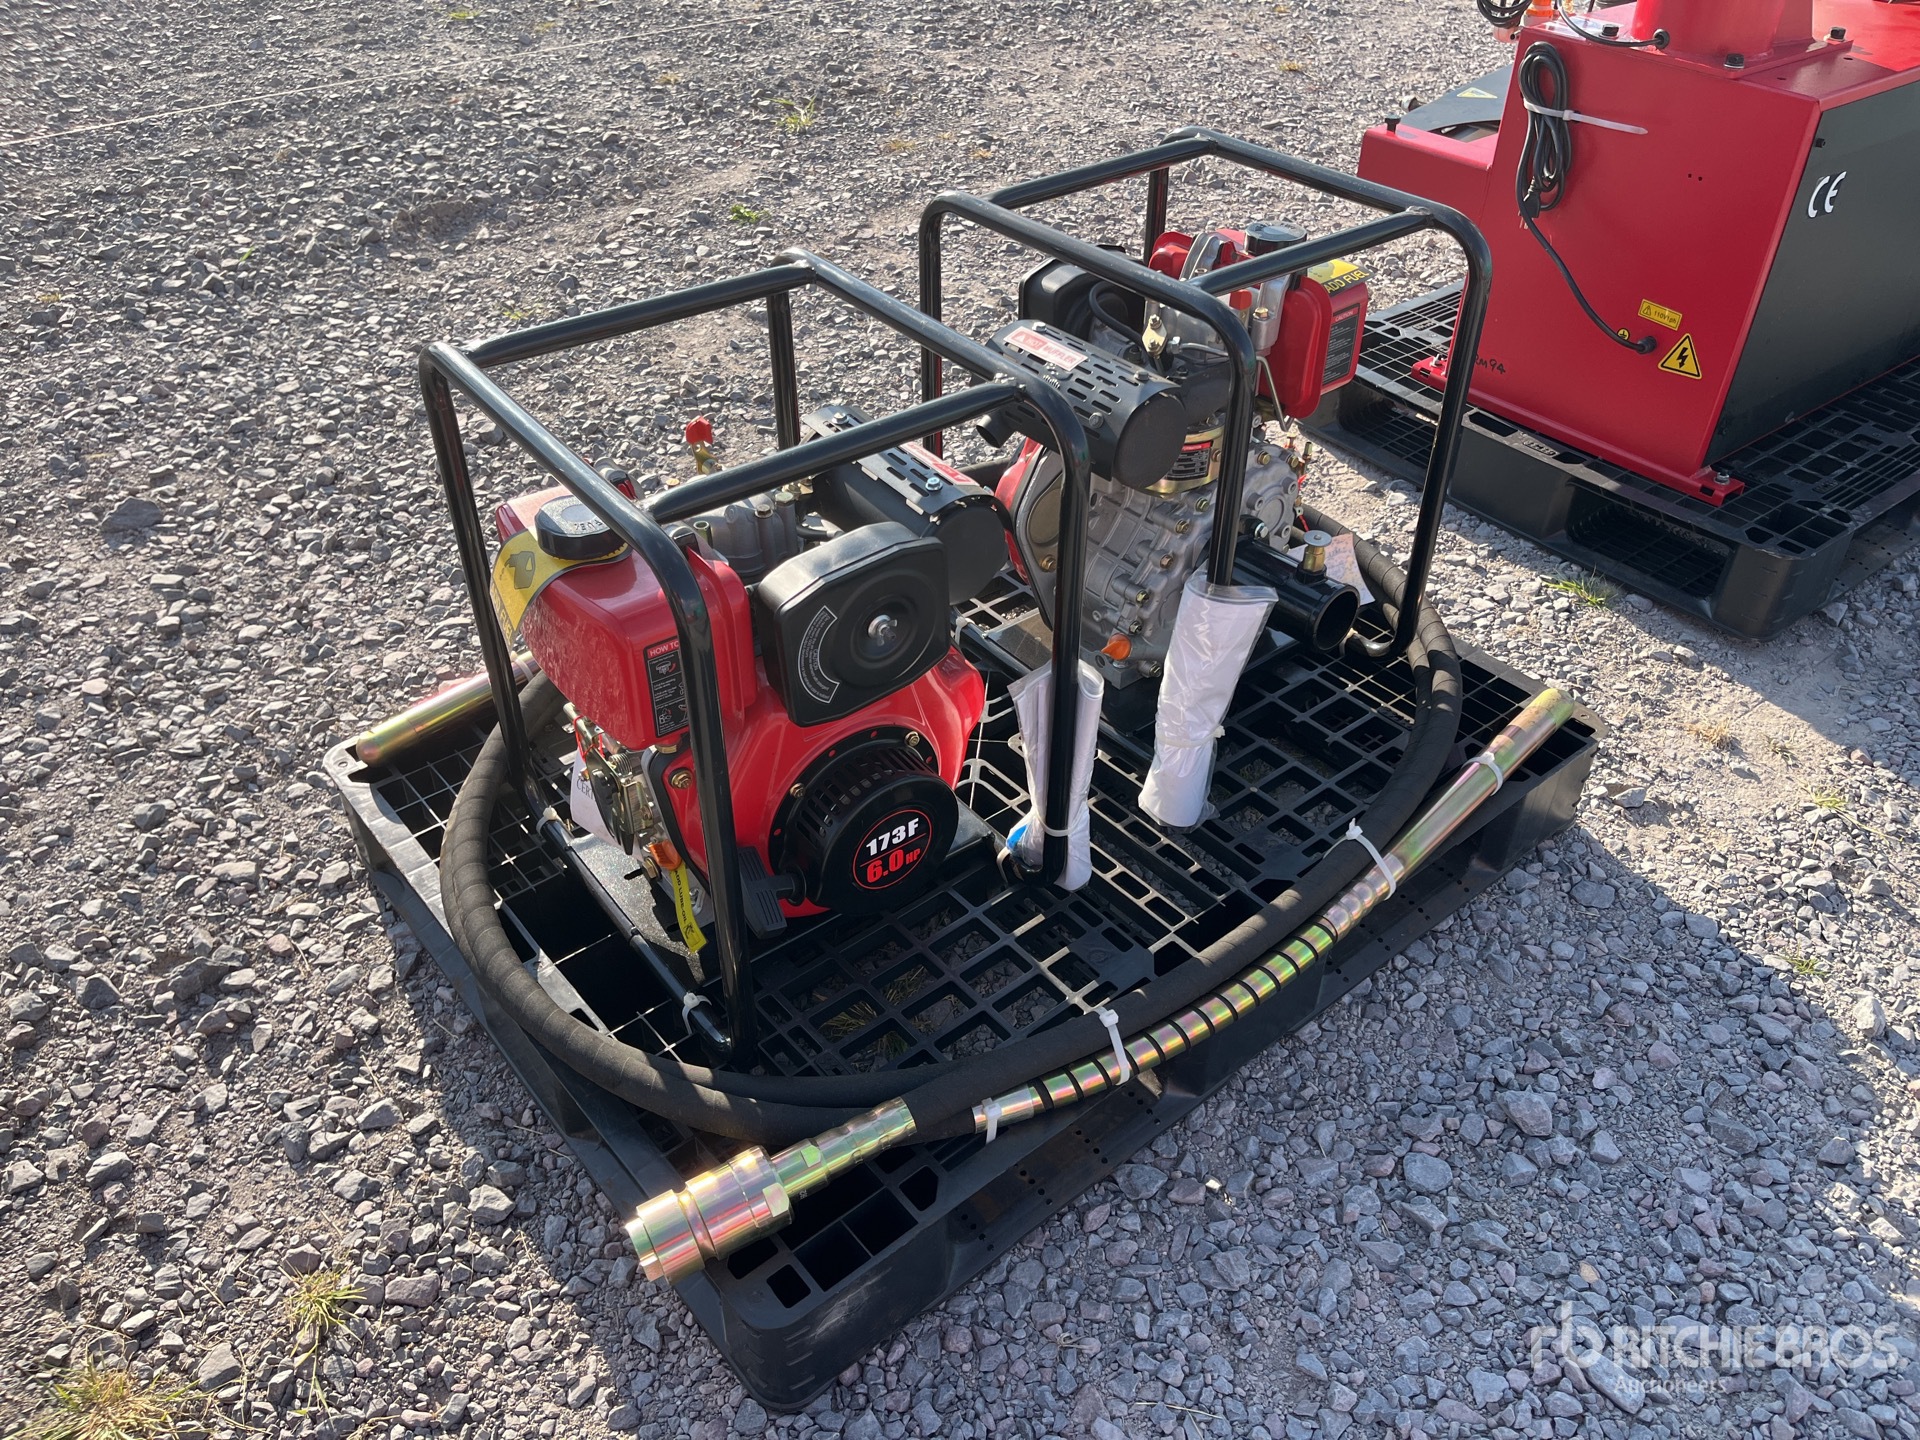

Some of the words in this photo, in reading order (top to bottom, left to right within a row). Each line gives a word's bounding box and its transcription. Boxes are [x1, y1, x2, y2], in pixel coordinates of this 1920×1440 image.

[1808, 171, 1847, 218] CE
[1324, 279, 1346, 293] ADD
[1343, 270, 1369, 283] FUEL
[650, 644, 669, 656] HOW
[866, 817, 919, 856] 173F
[867, 849, 904, 883] 6.0
[905, 848, 921, 865] HP
